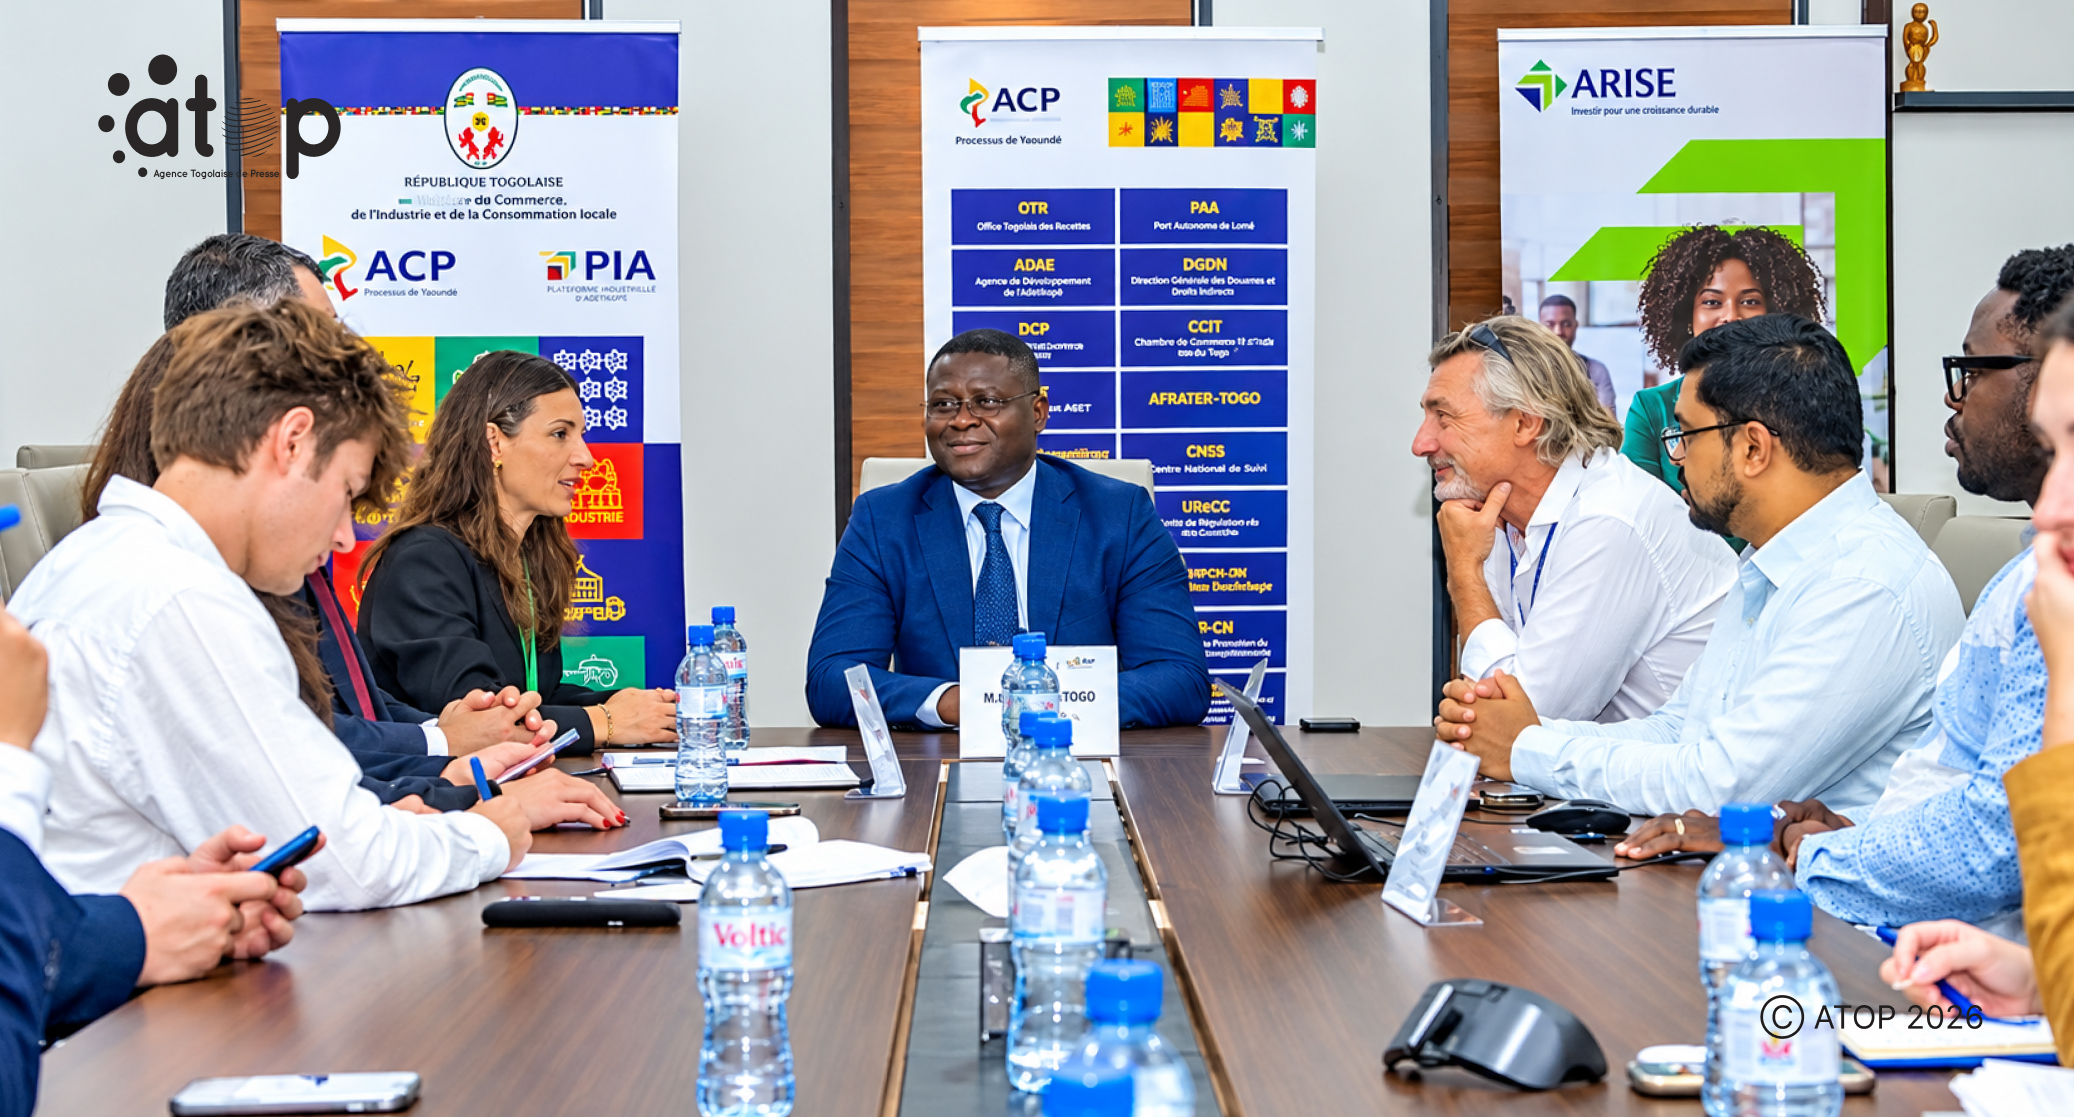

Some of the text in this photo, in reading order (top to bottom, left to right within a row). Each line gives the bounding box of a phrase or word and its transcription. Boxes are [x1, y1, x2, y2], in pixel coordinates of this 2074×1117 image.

[1571, 67, 1676, 99] ARISE
[991, 87, 1061, 113] ACP
[1571, 105, 1720, 117] Investir pour une croissance durable
[955, 135, 1062, 145] Processus de Yaoundé
[404, 174, 564, 189] RÉPUBLIQUE TOGOLAISE
[474, 195, 491, 206] du
[1190, 201, 1220, 214] PAA
[351, 209, 367, 220] de
[434, 210, 447, 220] et
[449, 208, 465, 220] de
[468, 208, 480, 220] la
[482, 208, 577, 220] Consommation
[580, 208, 617, 220] locale
[1018, 201, 1049, 215] OTR
[1153, 221, 1172, 230] Port
[364, 250, 457, 282] ACP
[585, 250, 657, 281] PIA
[1014, 258, 1055, 272] ADAE
[1183, 257, 1228, 271] DGDN
[364, 287, 458, 297] Processus de Yaoundé
[1018, 322, 1050, 336] DCP
[1188, 319, 1223, 334] CCIT
[1148, 391, 1261, 406] AFRATER-TOGO
[1186, 444, 1226, 459] CNSS
[1181, 500, 1231, 514] UReCC
[713, 922, 787, 947] Voltic
